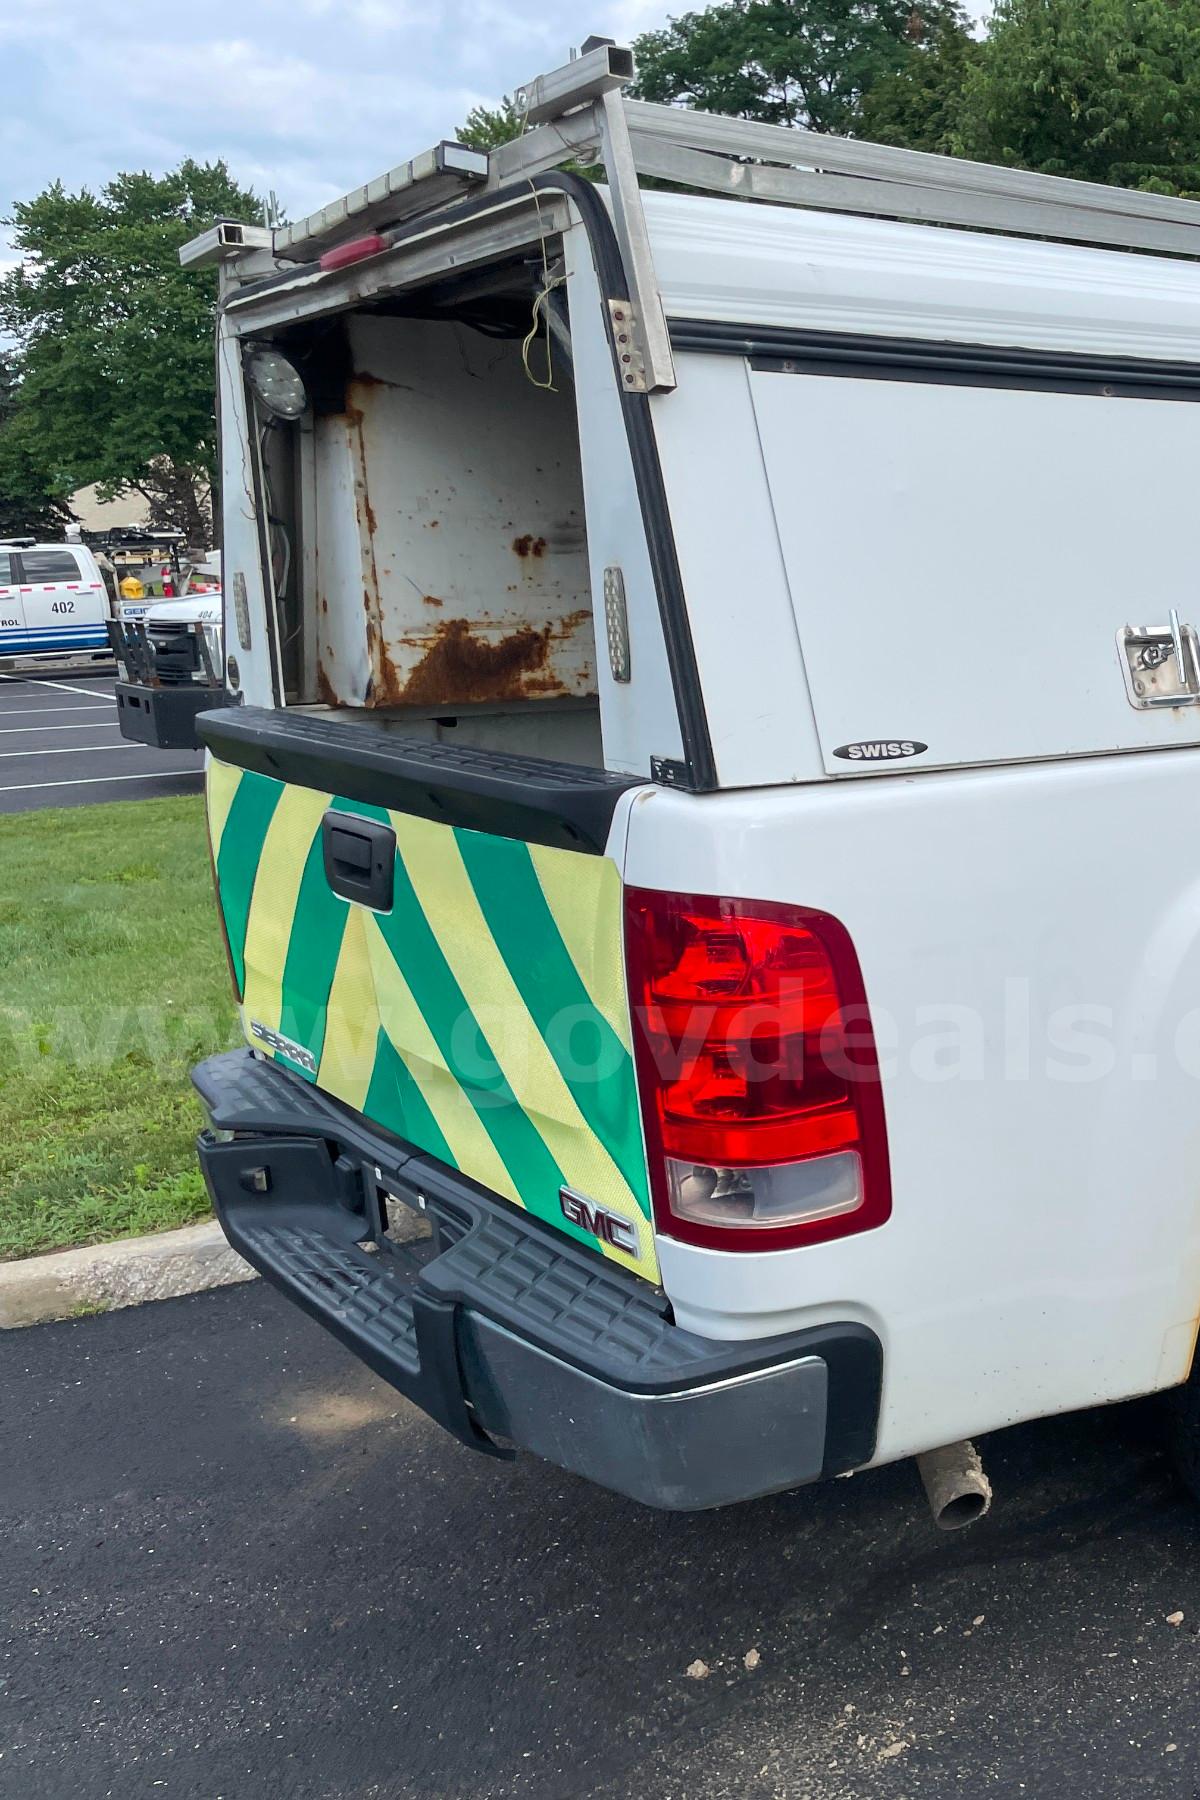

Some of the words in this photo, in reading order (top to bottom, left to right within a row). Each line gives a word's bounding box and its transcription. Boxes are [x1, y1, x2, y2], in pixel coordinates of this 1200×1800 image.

[51, 601, 75, 614] 402
[847, 742, 916, 759] SWISS
[558, 1186, 640, 1259] GMC
